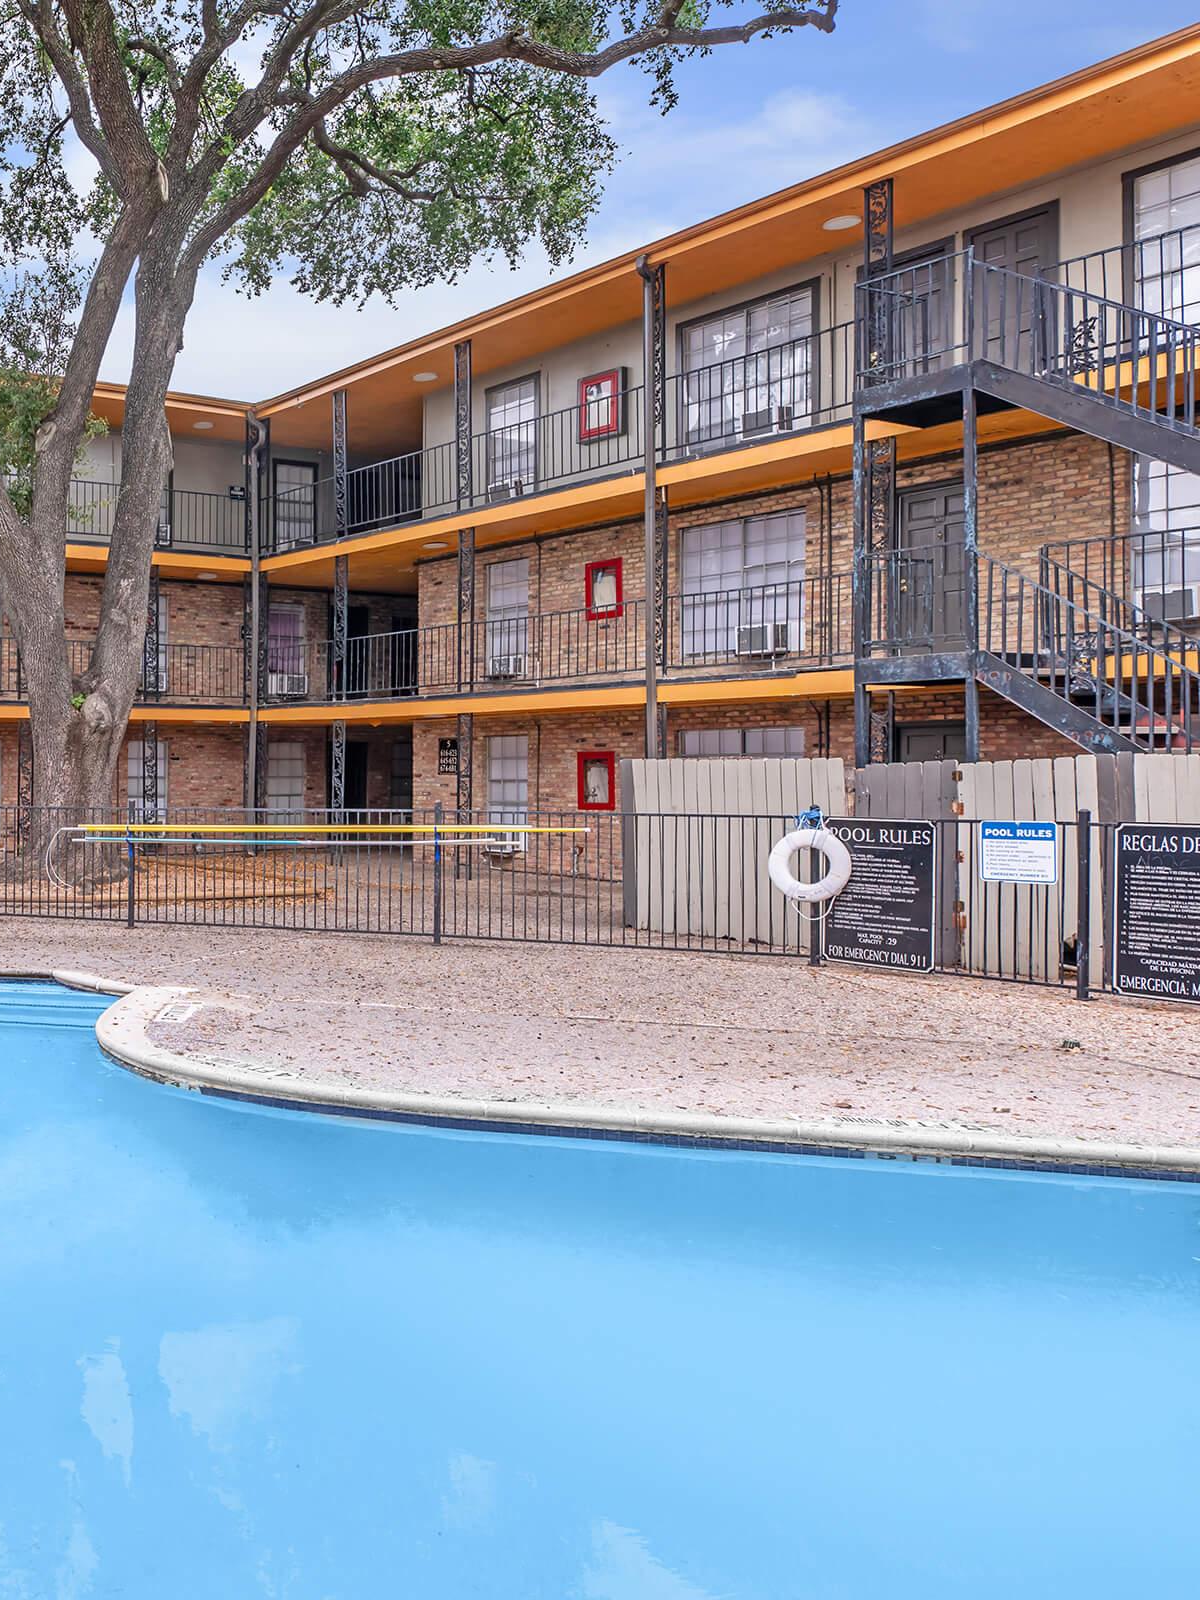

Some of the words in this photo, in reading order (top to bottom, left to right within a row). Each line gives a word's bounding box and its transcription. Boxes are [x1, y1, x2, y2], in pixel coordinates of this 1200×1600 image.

[879, 829, 931, 845] RULES
[984, 828, 1014, 837] POOL
[1016, 829, 1053, 838] RULES
[1122, 834, 1178, 852] REGLAS
[1182, 836, 1200, 853] DE
[828, 945, 843, 957] FOR
[844, 946, 890, 963] EMERGENCY
[891, 953, 909, 966] DIAL
[910, 954, 927, 968] 911
[1140, 958, 1177, 967] CAPACIDAD
[1169, 967, 1195, 975] PISCINA
[1120, 974, 1190, 995] EMERGENCIA:
